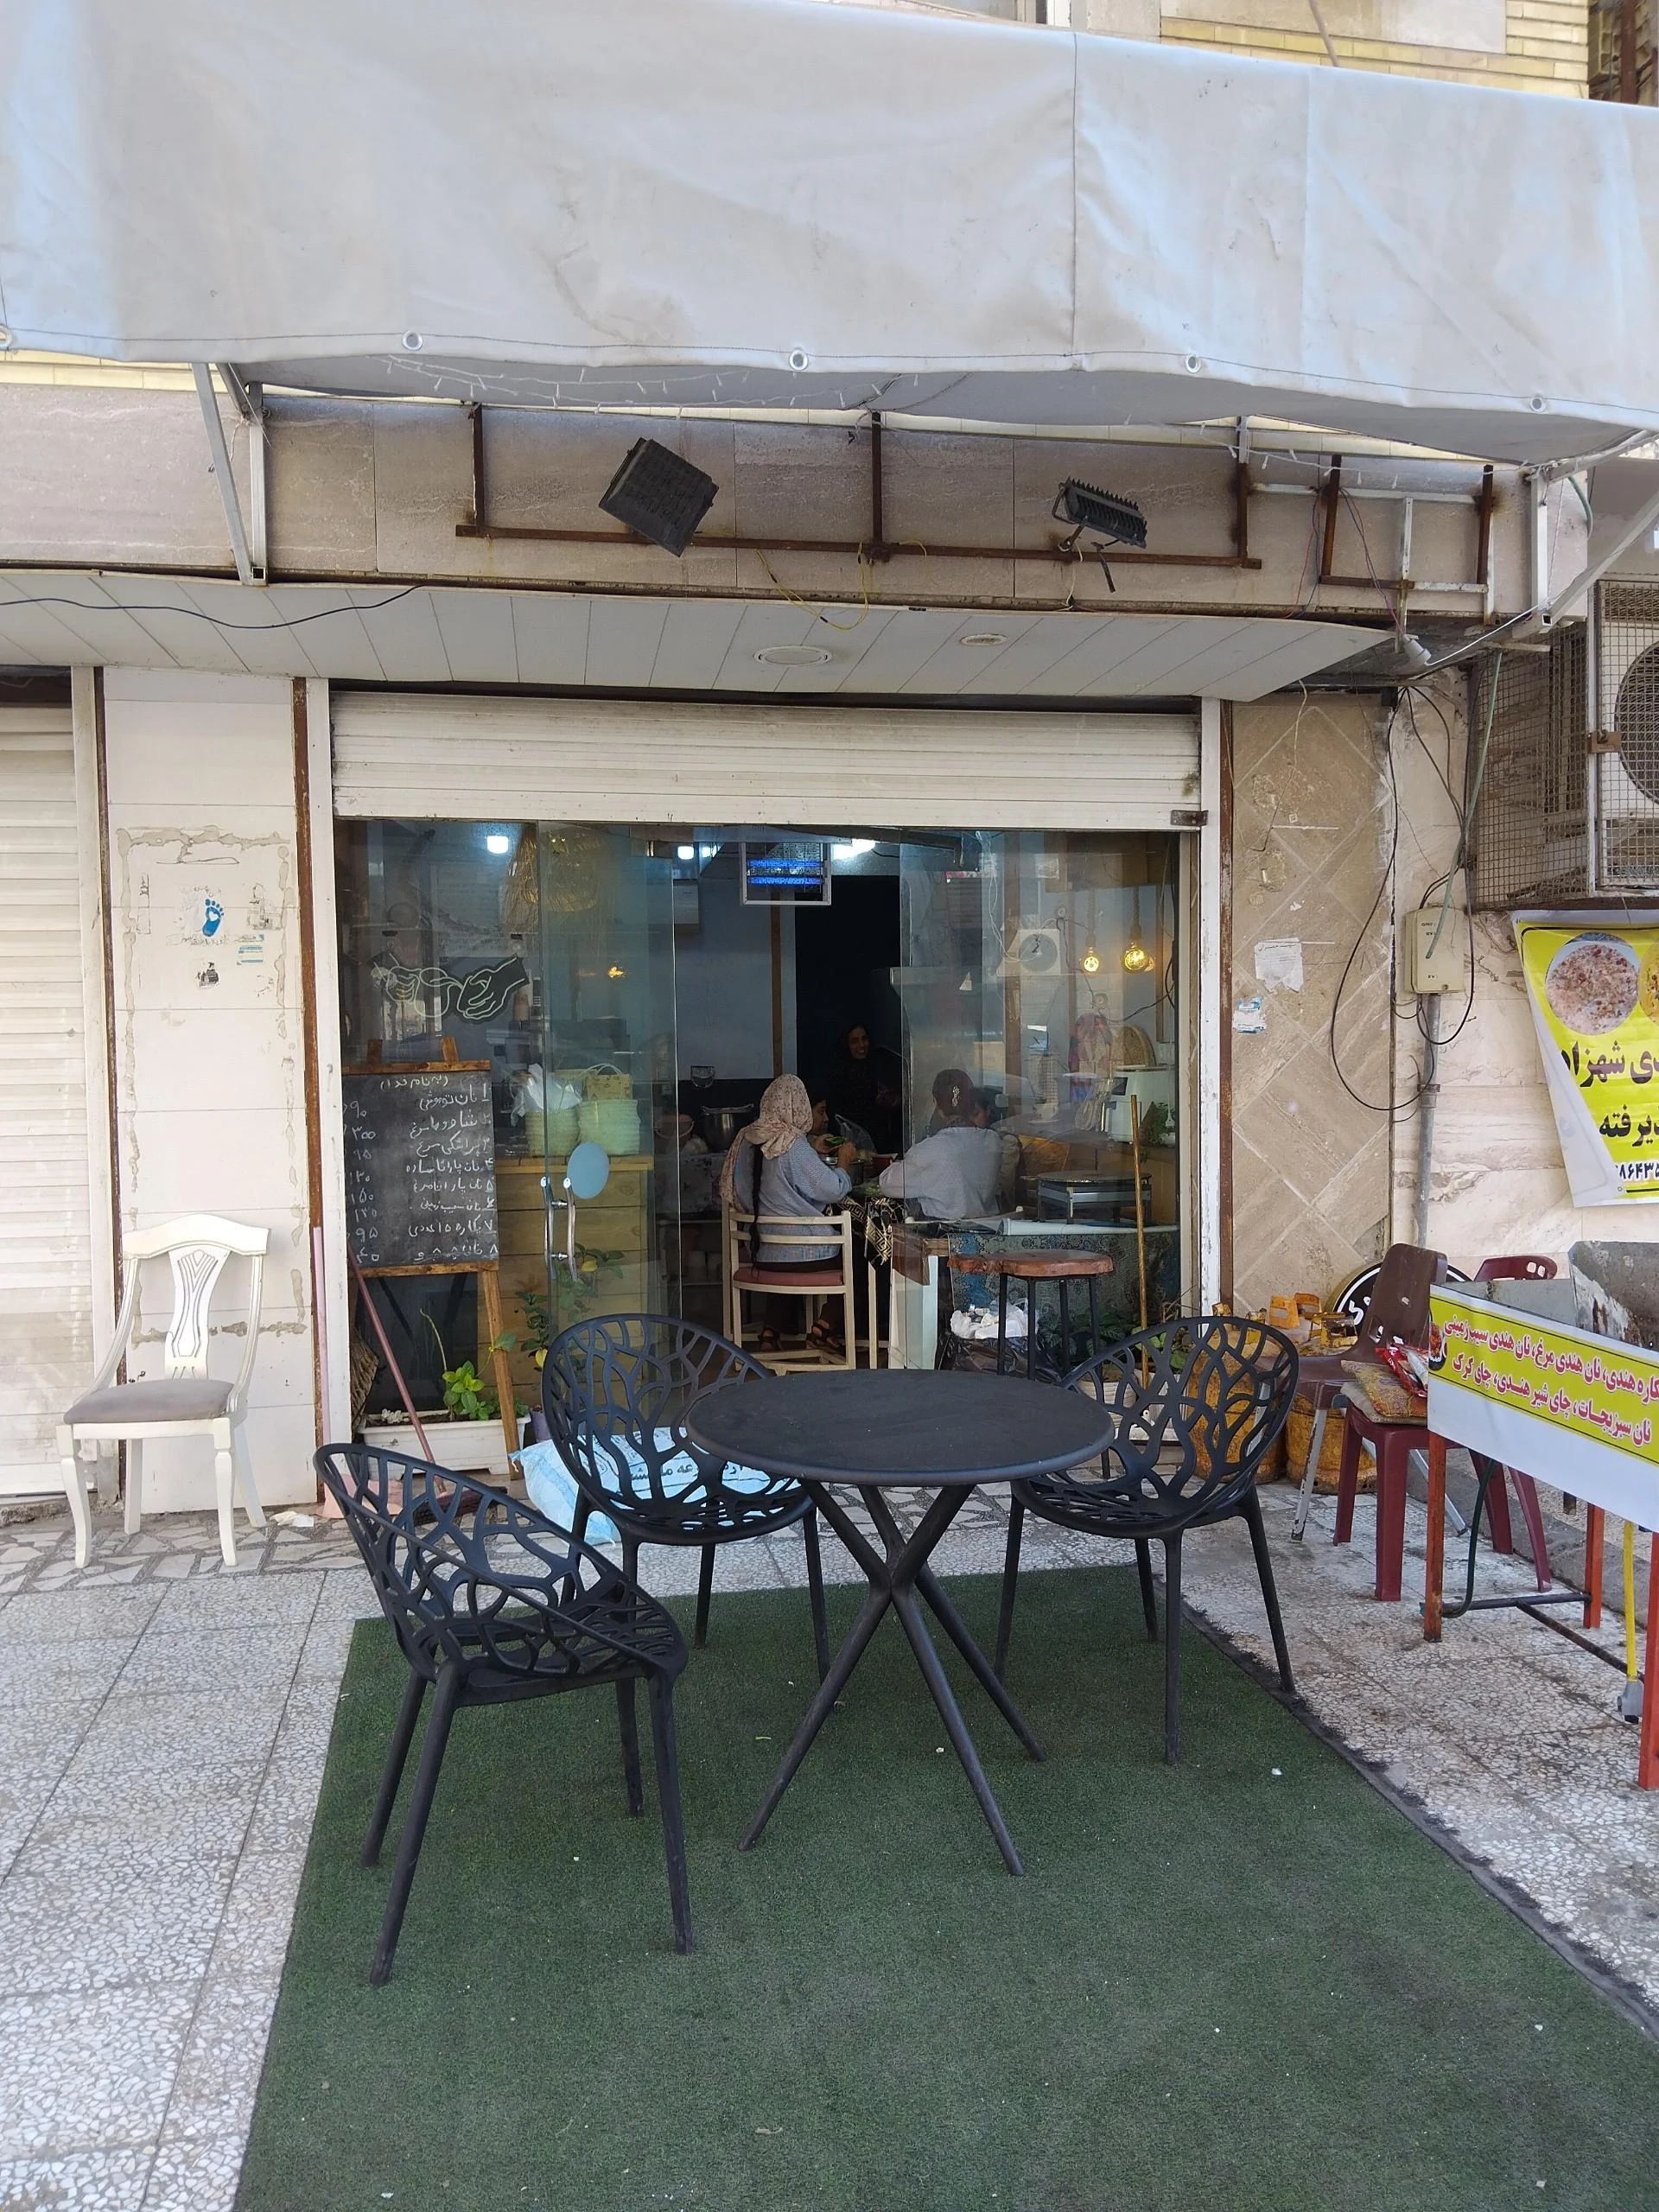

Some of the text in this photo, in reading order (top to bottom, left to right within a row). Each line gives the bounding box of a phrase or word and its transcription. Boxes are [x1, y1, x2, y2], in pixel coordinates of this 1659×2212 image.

[455, 1084, 477, 1105] نان
[352, 1126, 377, 1141] ۳۰۰
[464, 1160, 480, 1172] نان
[1488, 1331, 1515, 1353] هندی
[1515, 1333, 1531, 1361] نان
[1474, 1361, 1492, 1389] چای
[1555, 1352, 1584, 1376] هندی
[1583, 1357, 1601, 1385] نان
[1531, 1384, 1548, 1409] شیر
[1549, 1389, 1572, 1420] چای
[1633, 1420, 1652, 1447] نان
